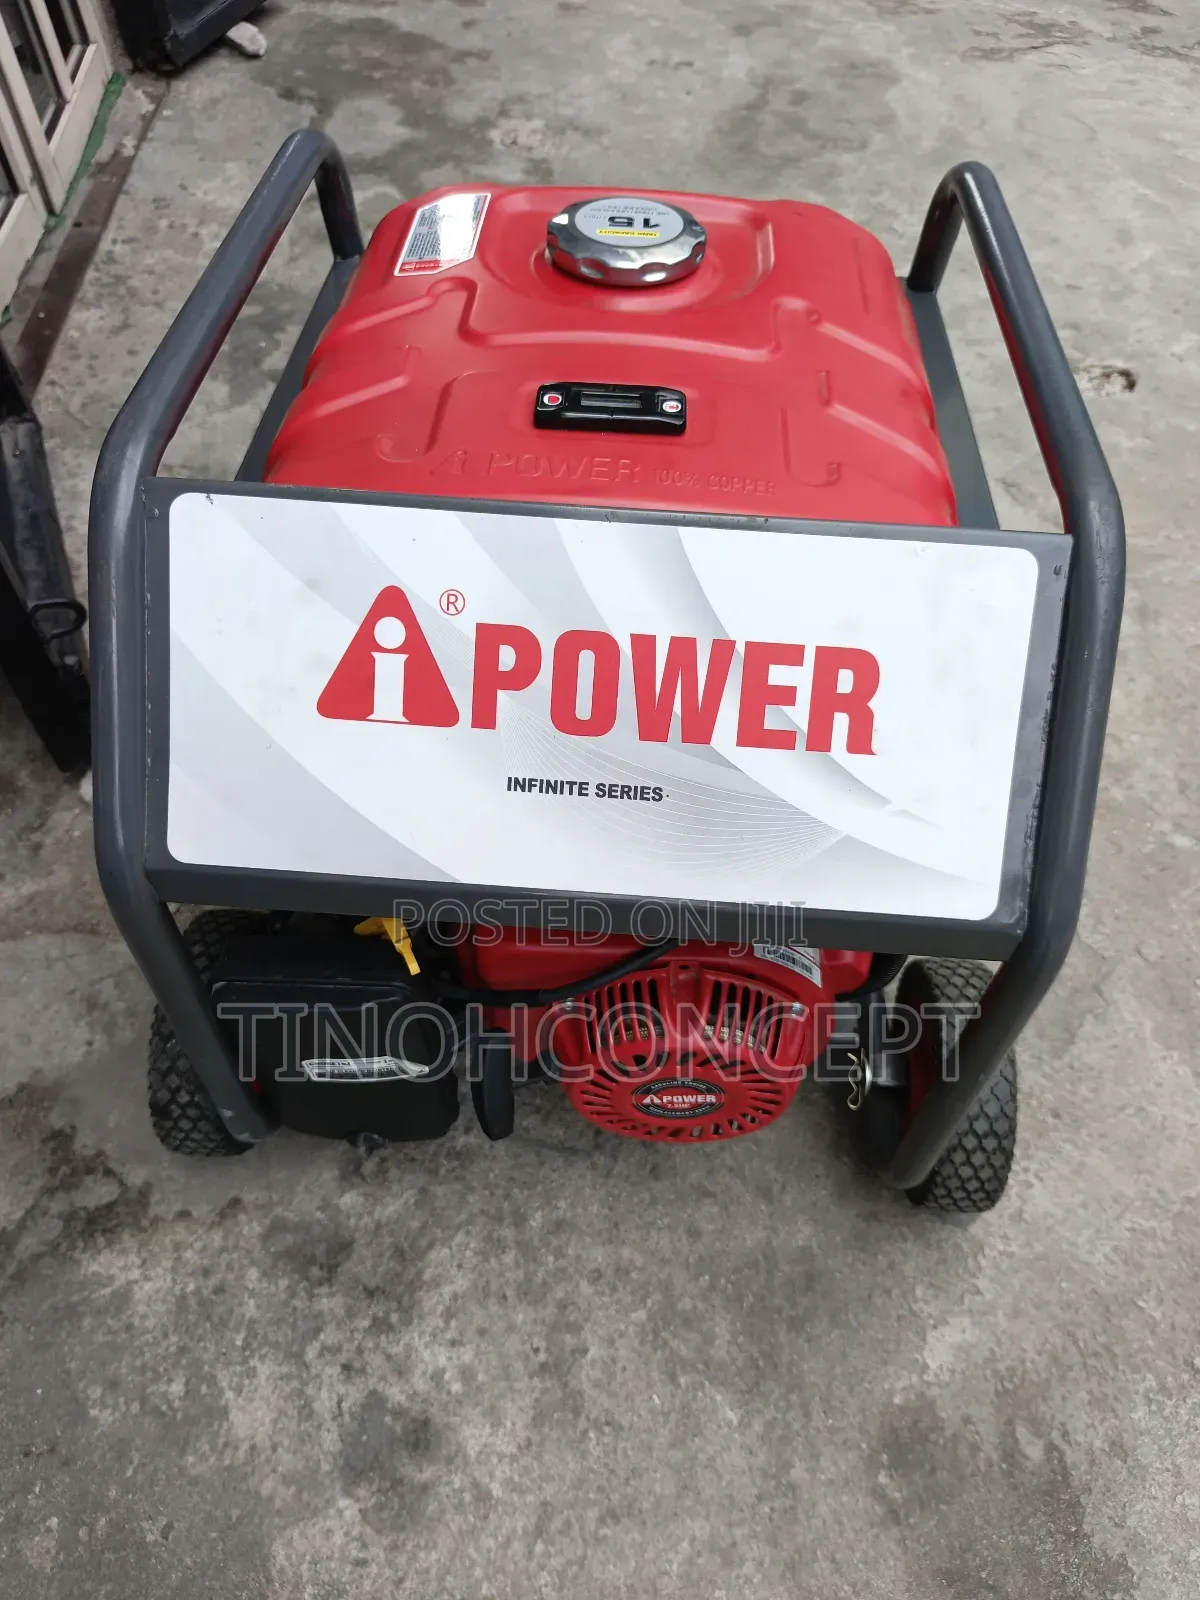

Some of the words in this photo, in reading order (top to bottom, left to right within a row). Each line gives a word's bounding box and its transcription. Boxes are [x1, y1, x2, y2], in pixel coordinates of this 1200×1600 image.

[608, 216, 661, 229] 15
[480, 452, 641, 484] POWER
[652, 468, 701, 489] 100%
[707, 472, 777, 498] COPPER
[471, 622, 880, 756] POWER
[506, 776, 590, 797] INFINITE
[594, 782, 664, 802] SERIES
[662, 1094, 717, 1104] POWER
